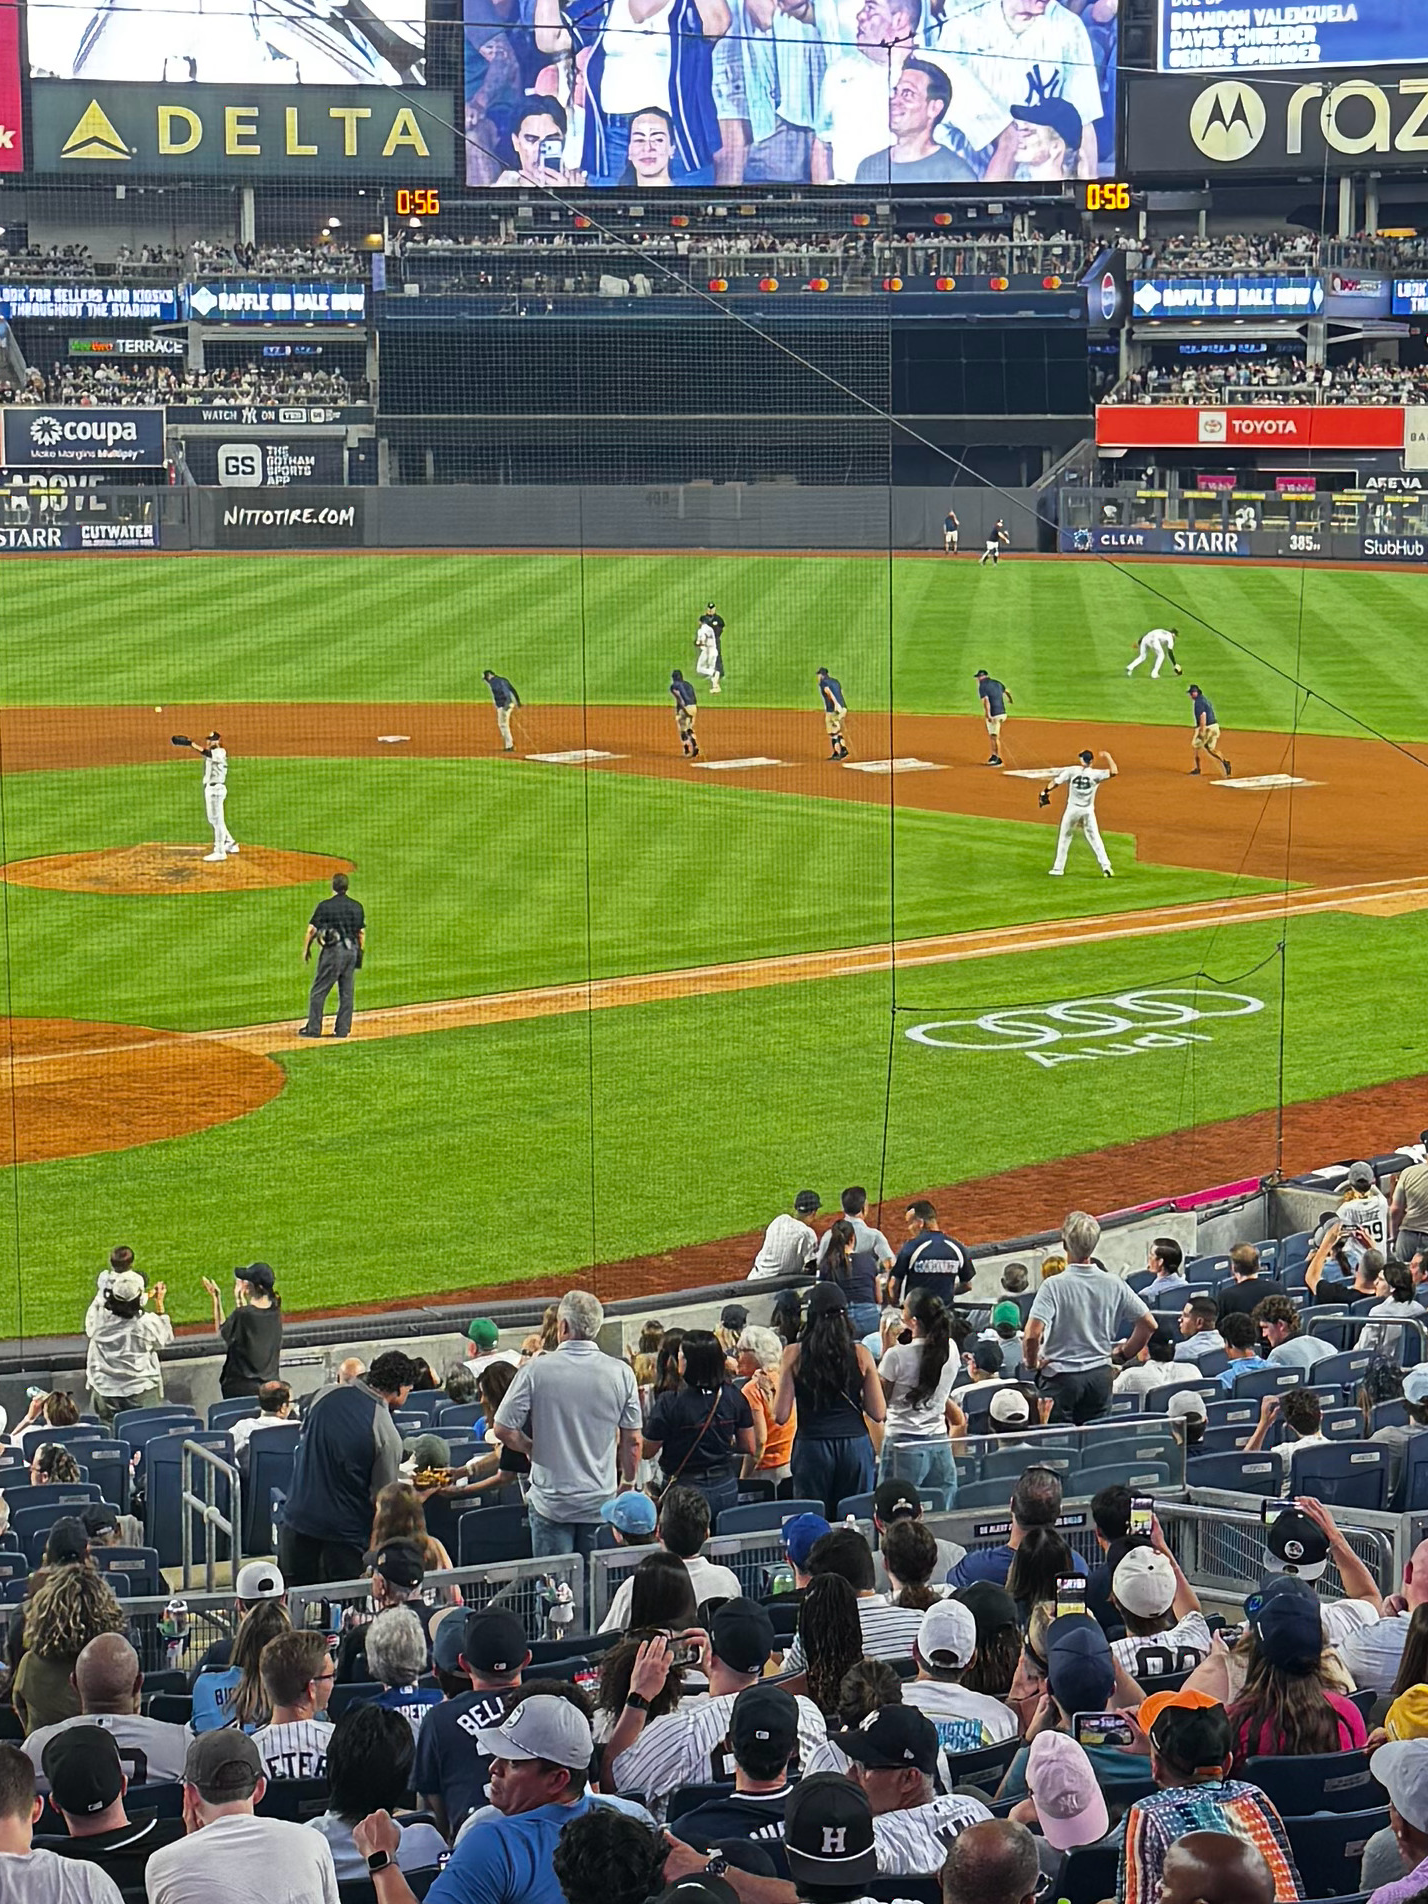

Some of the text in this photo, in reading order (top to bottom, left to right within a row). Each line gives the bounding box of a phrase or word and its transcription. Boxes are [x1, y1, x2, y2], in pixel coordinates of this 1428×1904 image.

[158, 105, 429, 156] DELTA
[397, 190, 439, 215] 0:56
[1087, 183, 1129, 210] 0:56
[116, 340, 183, 353] TERRACE
[63, 420, 137, 446] coupa
[1232, 419, 1297, 435] TOYOTA
[225, 456, 256, 476] GS
[224, 506, 355, 527] NITTOTIRE.COM
[81, 525, 153, 538] CUTWATER
[1101, 534, 1144, 545] CLEAR
[1174, 532, 1238, 552] STARR
[1290, 535, 1313, 550] 385
[1364, 539, 1423, 556] StubHub
[1023, 1030, 1215, 1067] Audi
[822, 1827, 846, 1852] H
